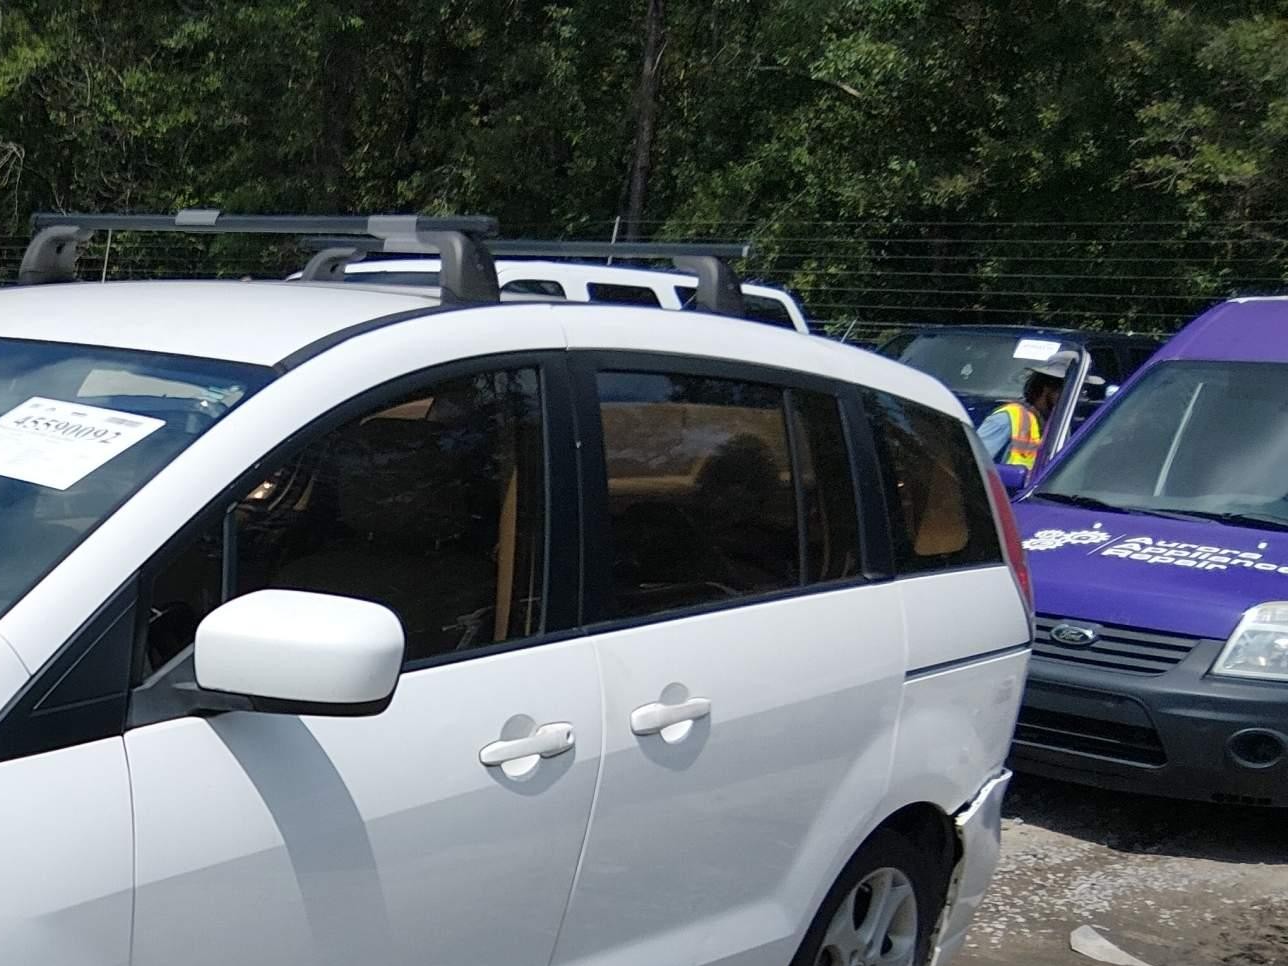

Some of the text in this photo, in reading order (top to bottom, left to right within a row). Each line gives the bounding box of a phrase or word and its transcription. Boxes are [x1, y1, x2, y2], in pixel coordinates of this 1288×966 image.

[13, 414, 123, 445] 45590092
[1101, 548, 1228, 570] Repair
[1124, 537, 1263, 560] Aurora
